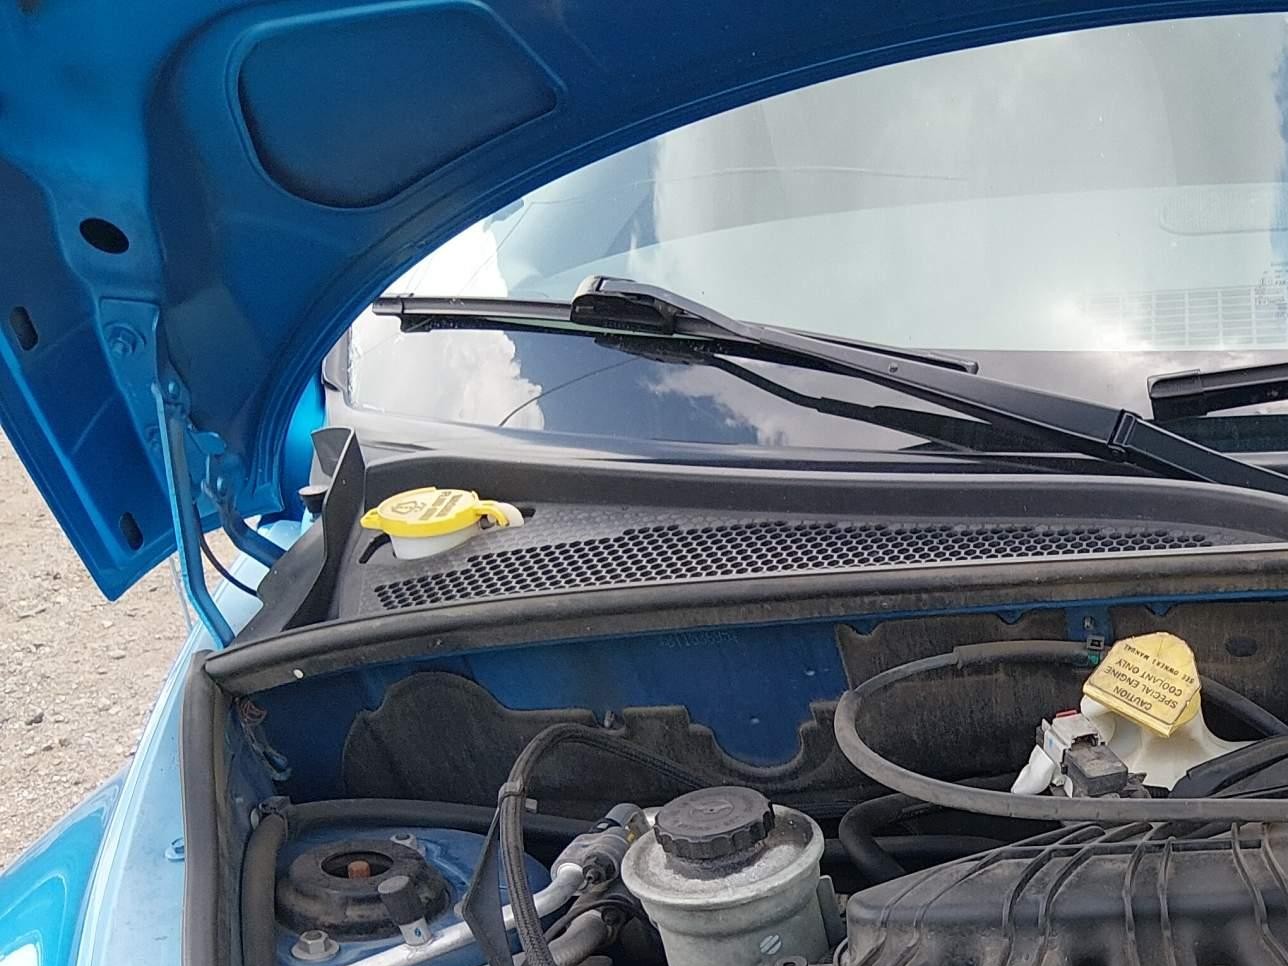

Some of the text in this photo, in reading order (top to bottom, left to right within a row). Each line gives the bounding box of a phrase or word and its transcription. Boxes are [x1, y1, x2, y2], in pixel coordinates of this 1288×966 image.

[1103, 665, 1179, 709] SPECIAL ENGINE
[1115, 657, 1183, 697] COOLANT ONLY
[1113, 685, 1153, 711] CAUTION
